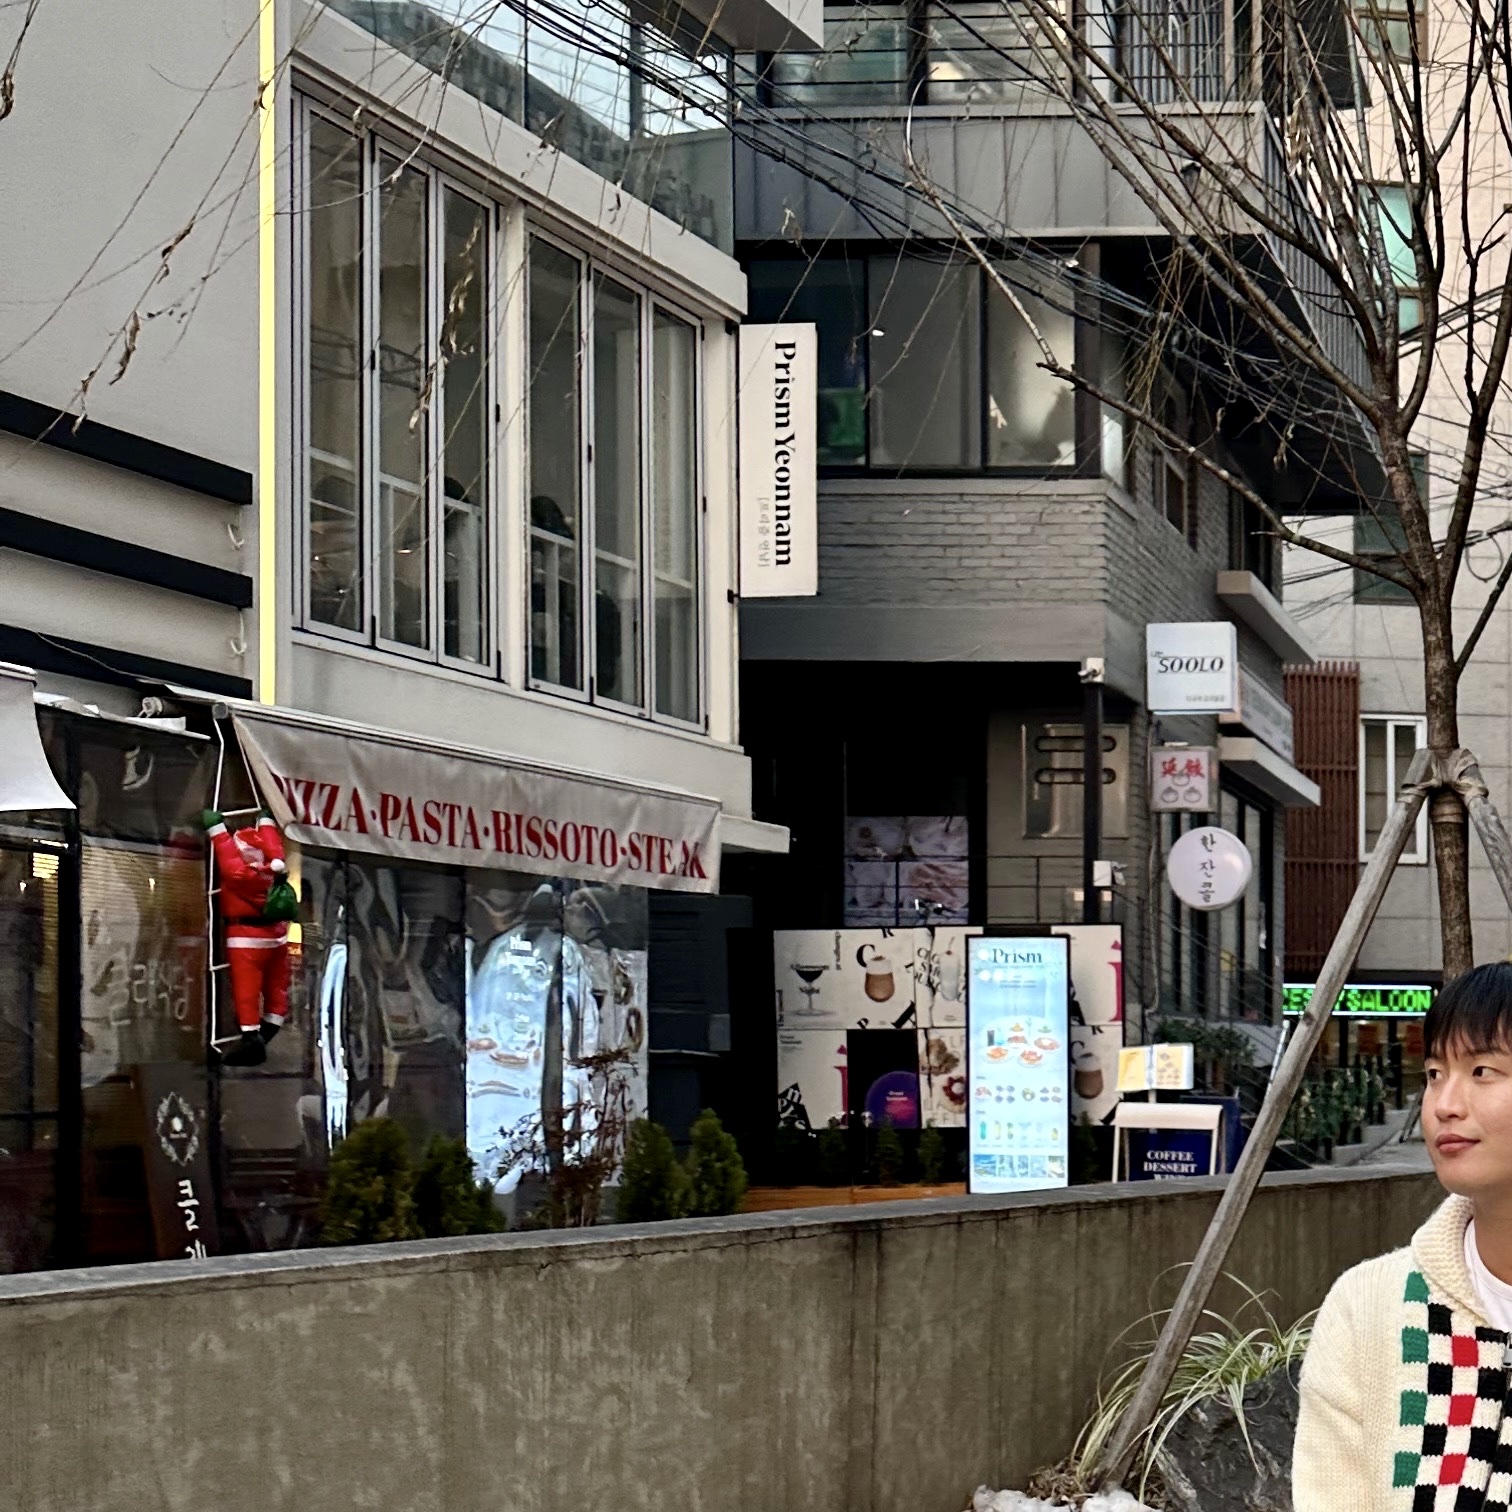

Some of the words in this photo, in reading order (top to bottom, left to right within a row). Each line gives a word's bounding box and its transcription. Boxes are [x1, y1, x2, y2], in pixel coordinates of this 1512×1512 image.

[774, 342, 796, 428] Prism
[774, 432, 796, 566] Yeonnam
[1157, 656, 1224, 674] SOOLO
[377, 792, 482, 851] PASTA
[490, 809, 618, 868] RISSOTO
[992, 948, 1042, 964] Prism
[1347, 989, 1431, 1012] SALOON
[1146, 1150, 1194, 1161] COFFEE
[1143, 1161, 1198, 1173] DESSERT
